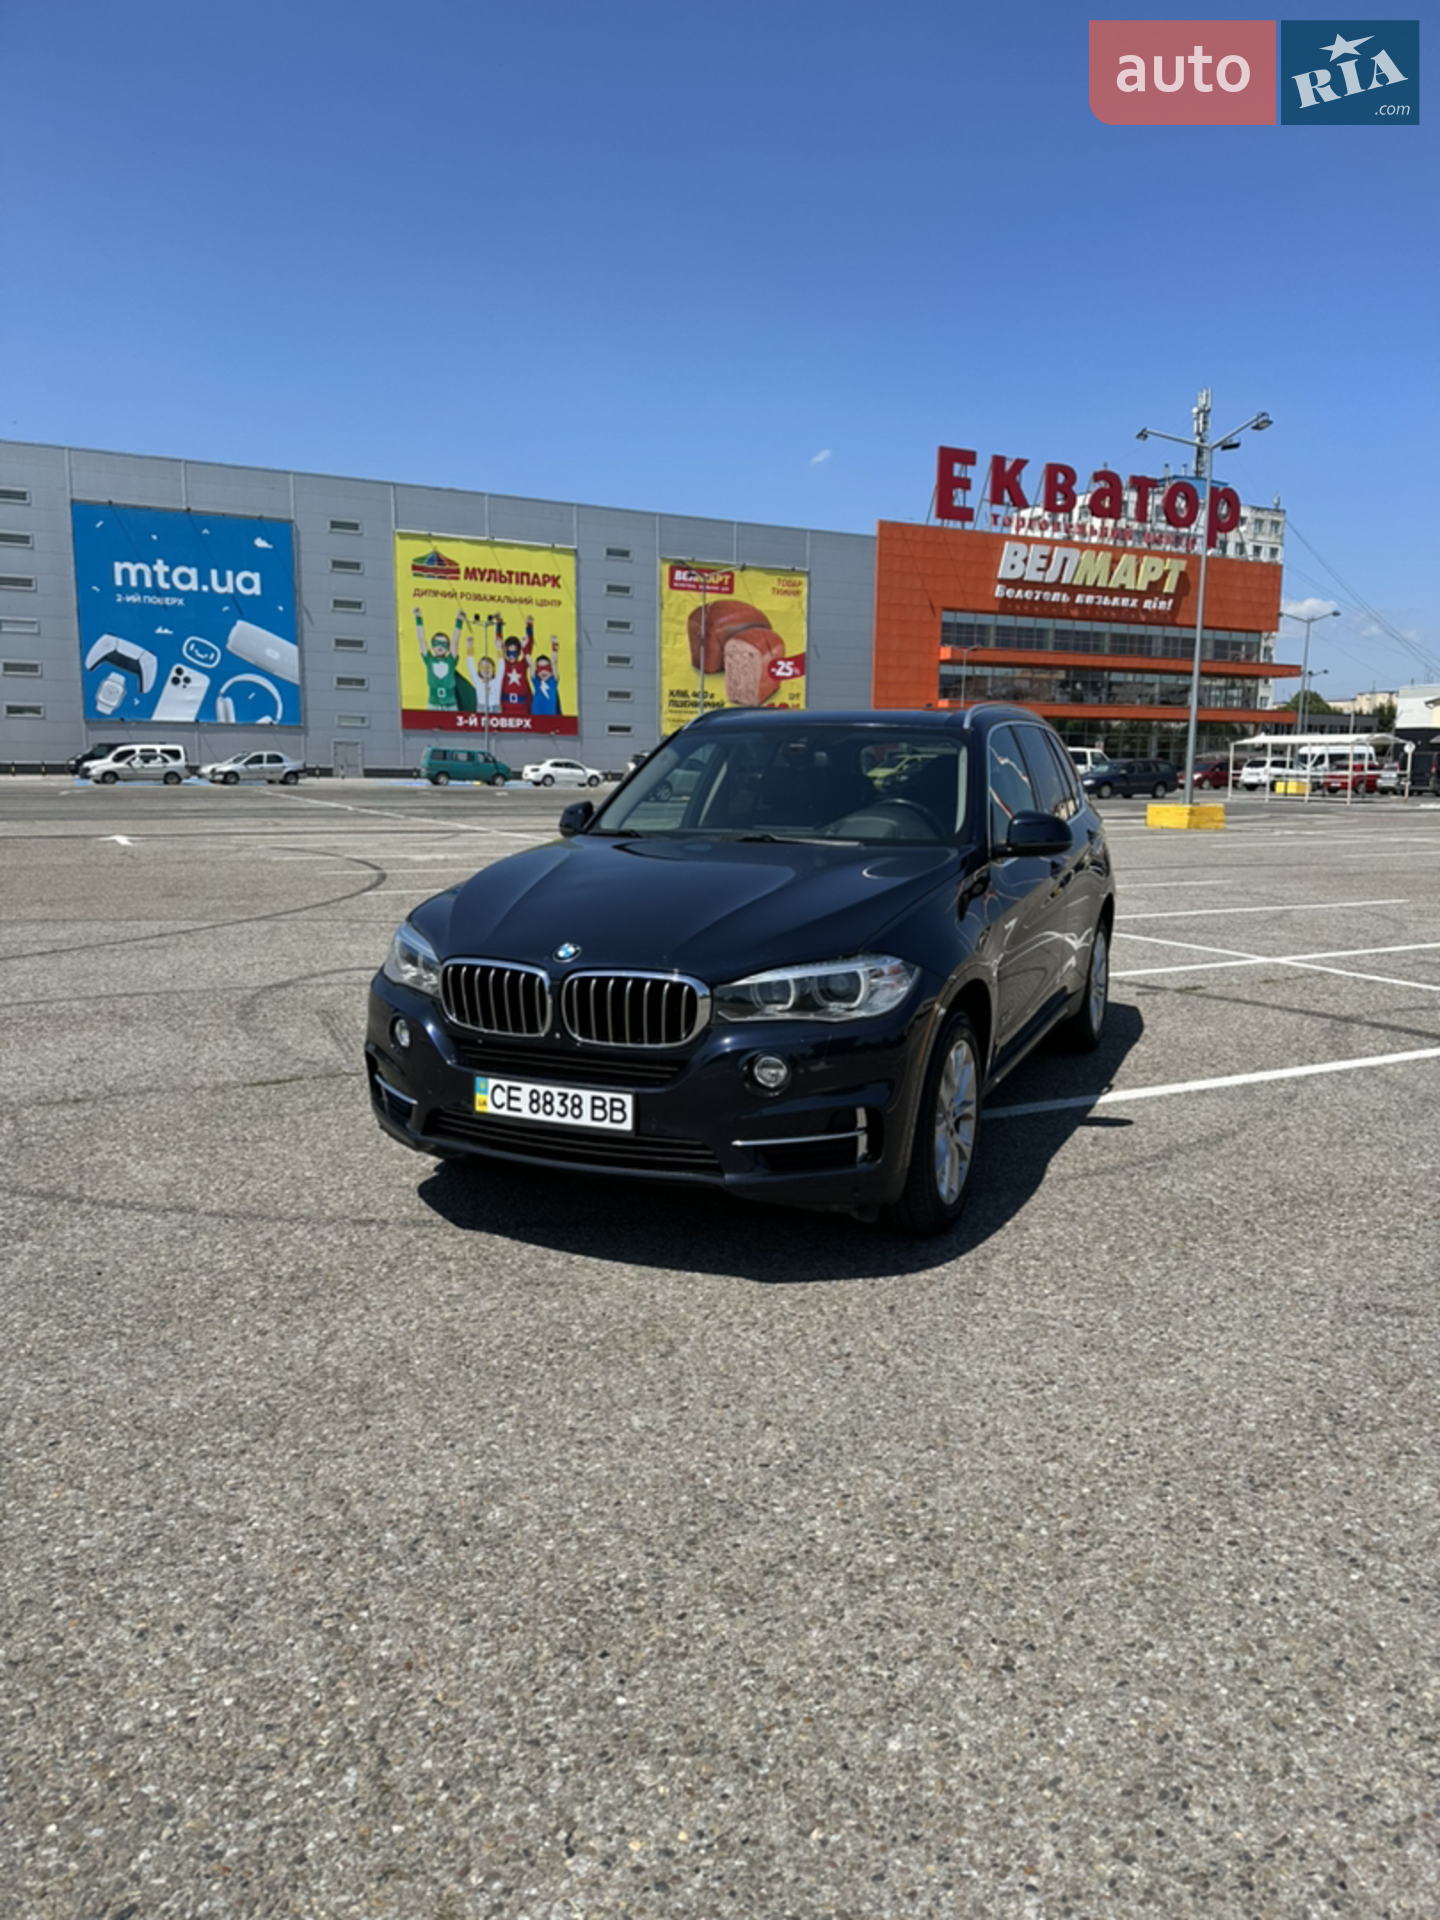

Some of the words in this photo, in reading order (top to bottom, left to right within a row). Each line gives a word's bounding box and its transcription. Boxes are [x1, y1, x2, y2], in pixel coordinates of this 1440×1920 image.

[113, 558, 261, 596] mta.ua
[463, 566, 561, 589] МУЛЬТІПАРК
[997, 540, 1187, 594] ВЕЛМАРТ
[456, 714, 478, 727] 3-Й
[490, 1084, 522, 1112] CE
[528, 1089, 583, 1119] 8838
[590, 1095, 627, 1124] BB
